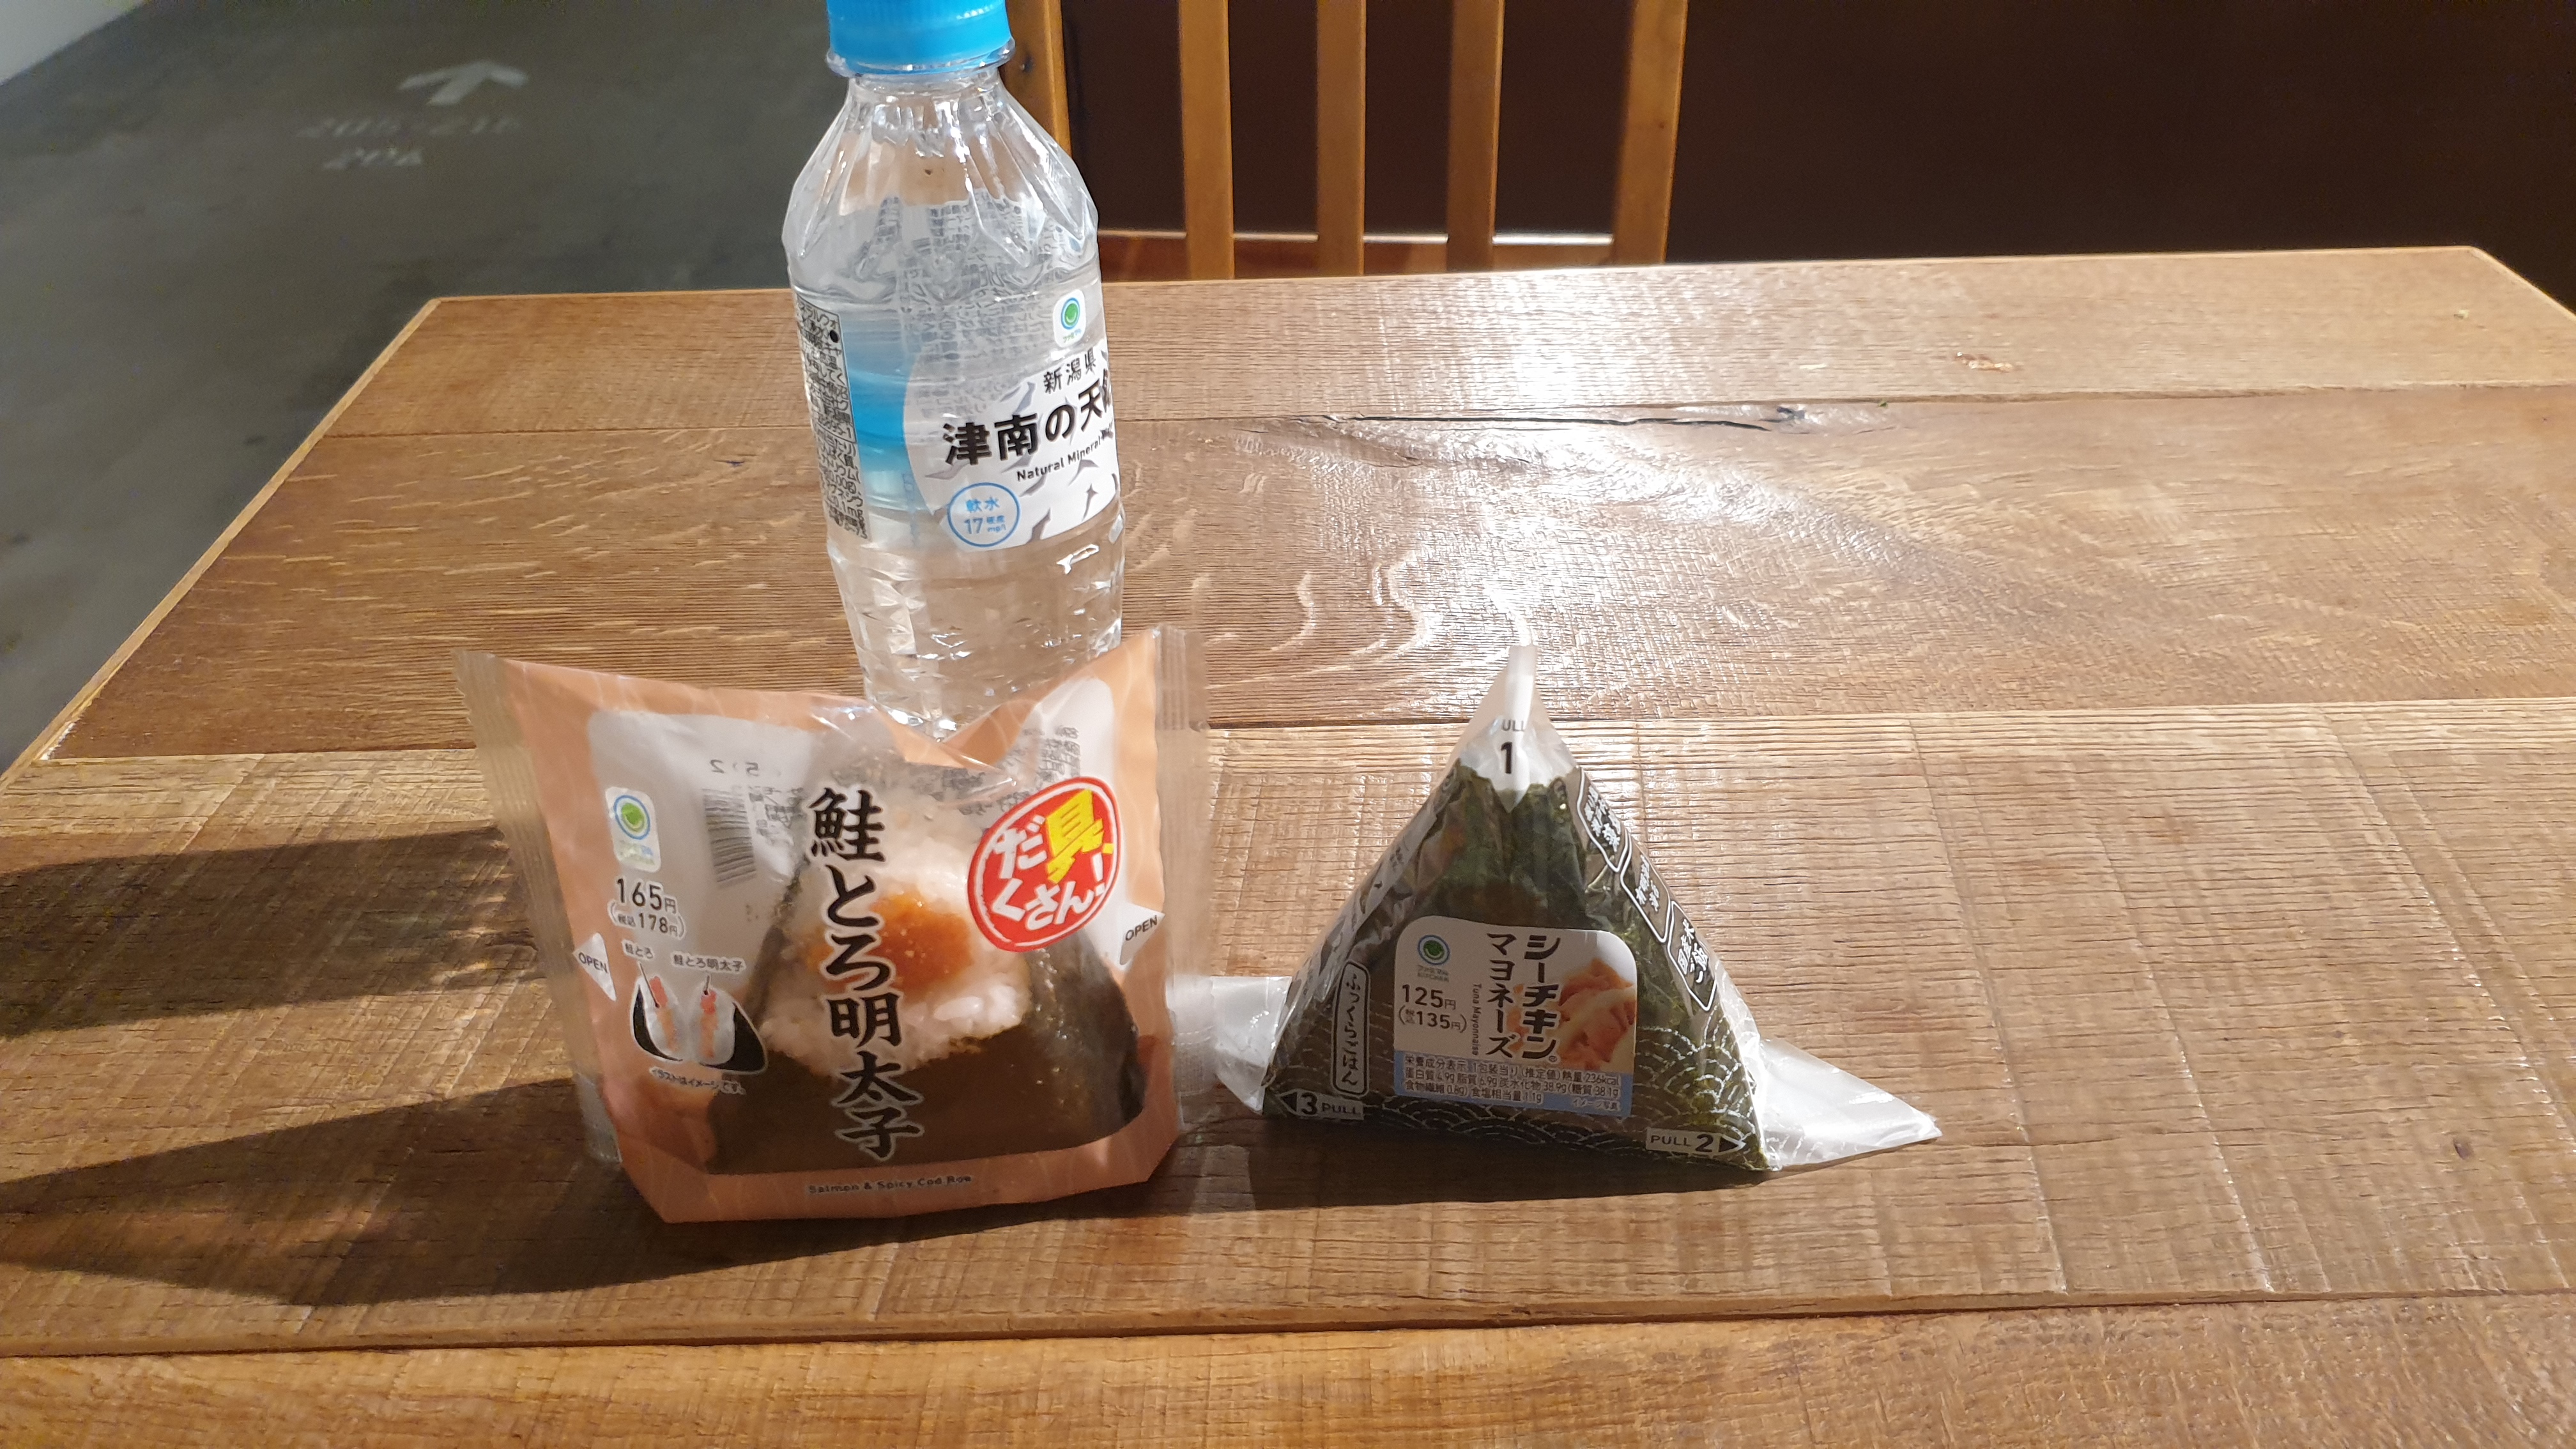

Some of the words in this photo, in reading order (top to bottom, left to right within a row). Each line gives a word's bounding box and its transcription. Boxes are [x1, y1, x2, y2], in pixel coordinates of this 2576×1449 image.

[1043, 347, 1096, 394] 新潟県
[1016, 457, 1065, 482] Natural
[1068, 436, 1101, 464] Mineral
[964, 517, 984, 534] 17
[1501, 741, 1513, 774] 1
[617, 878, 677, 914] 165円
[1125, 915, 1158, 942] OPEN
[578, 951, 608, 974] OPEN
[673, 954, 744, 972] 鮭とろ明太子
[1677, 919, 1695, 975] 国産米
[1690, 942, 1709, 983] ご飯
[808, 787, 921, 1157] 鮭とろ明太子
[1402, 984, 1456, 1010] 125円
[1473, 983, 1482, 1004] Tuna
[1486, 932, 1517, 1059] マヨネーズ
[1341, 972, 1361, 1086] ふっくらごはん
[1471, 1006, 1482, 1055] Mayonnaise
[1300, 1092, 1318, 1116] 3
[1321, 1101, 1358, 1116] PULL
[1650, 1135, 1692, 1147] PULL
[1696, 1133, 1715, 1152] 2
[809, 1184, 860, 1193] Salmon
[877, 1180, 912, 1190] Spicy
[917, 1177, 942, 1186] Cod
[946, 1175, 972, 1184] Roe
